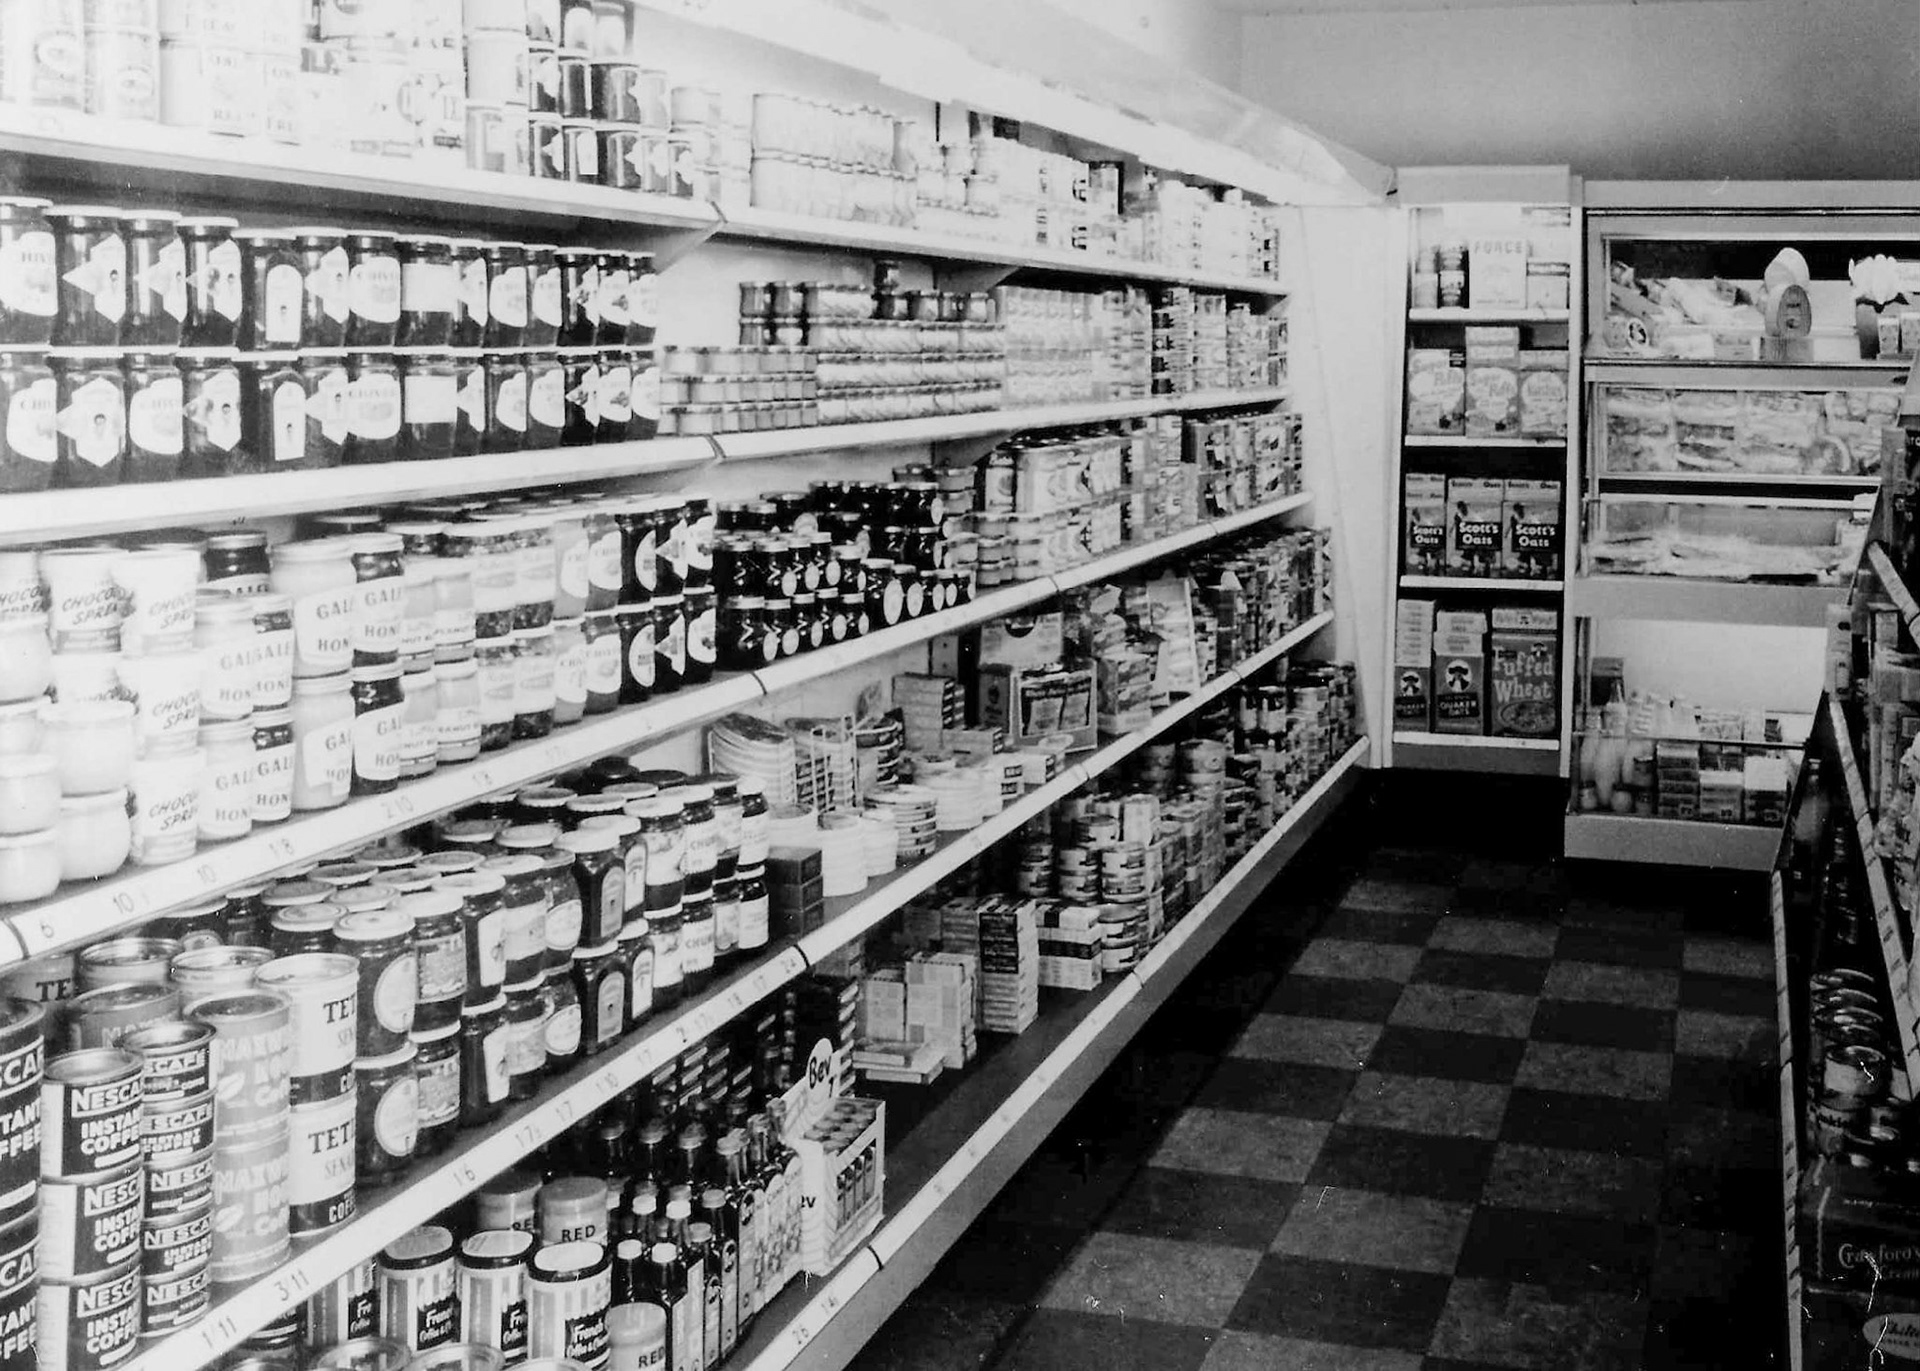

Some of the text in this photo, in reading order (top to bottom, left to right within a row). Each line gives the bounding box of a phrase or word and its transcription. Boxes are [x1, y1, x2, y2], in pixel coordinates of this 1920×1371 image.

[1459, 521, 1499, 535] Scott's
[1516, 523, 1556, 536] Scott's
[1414, 534, 1439, 545] Oats
[1462, 533, 1493, 545] Oats
[1518, 535, 1550, 548] Oats
[1491, 645, 1554, 677] Puffed
[1493, 676, 1552, 703] Wheat
[809, 1056, 833, 1091] Bev
[561, 1224, 597, 1243] RED
